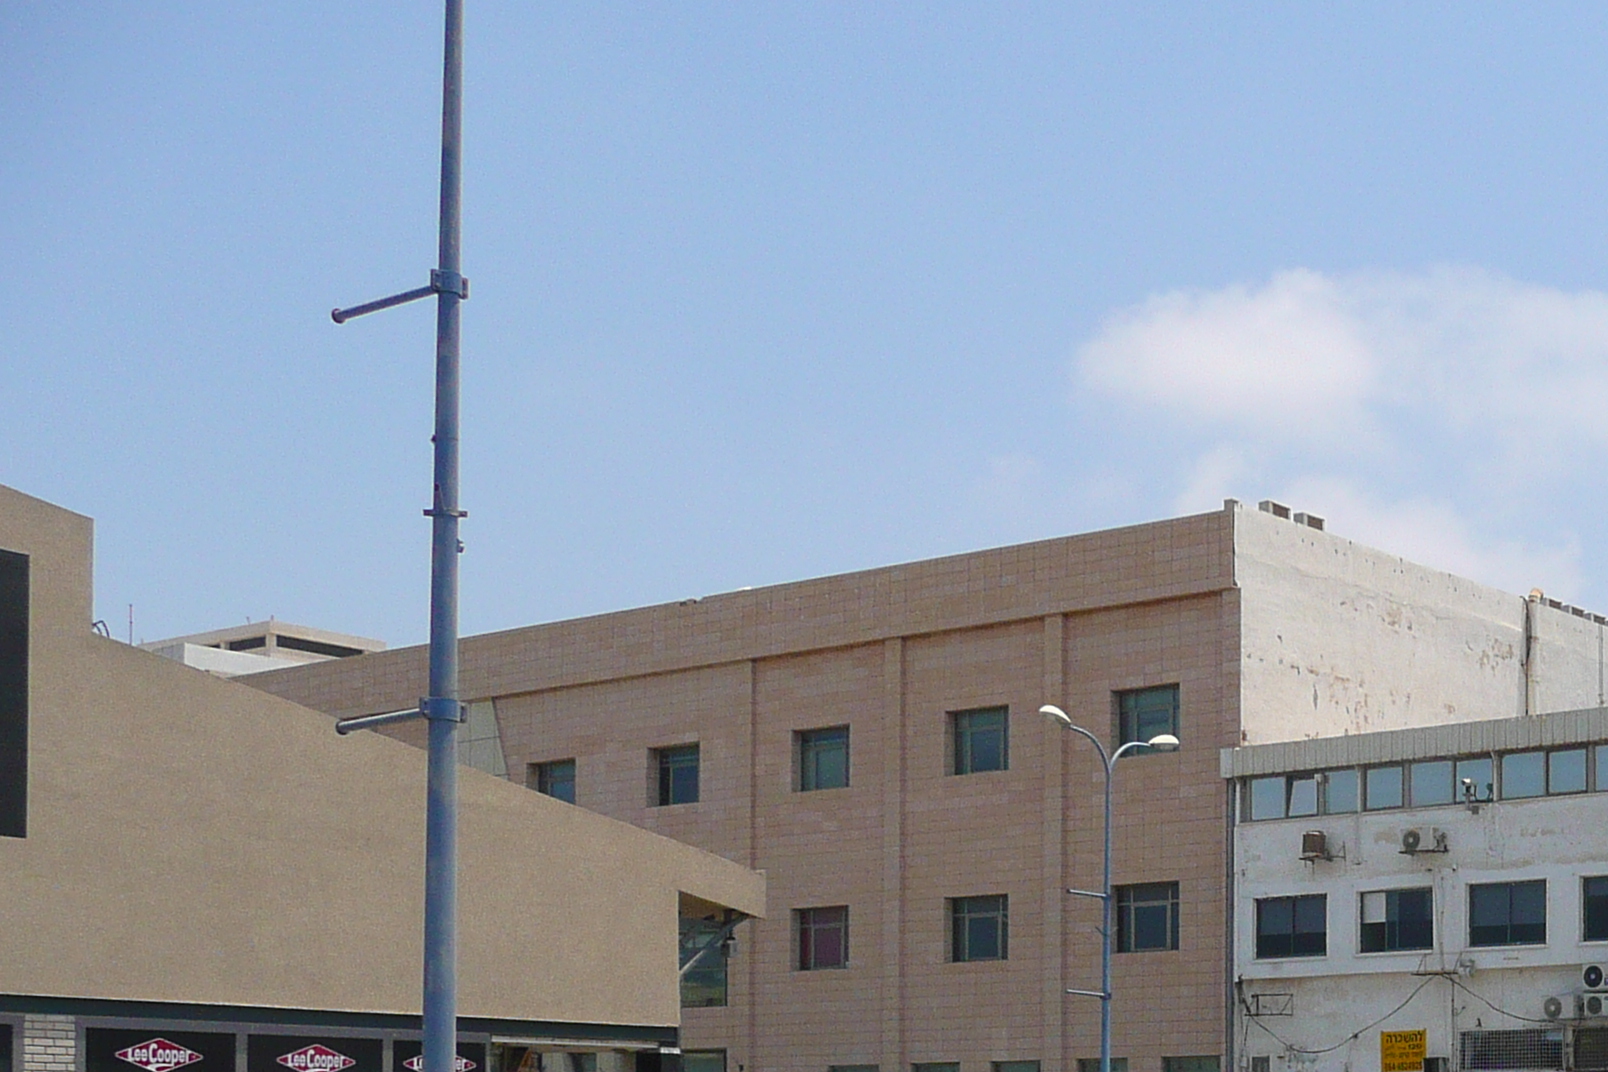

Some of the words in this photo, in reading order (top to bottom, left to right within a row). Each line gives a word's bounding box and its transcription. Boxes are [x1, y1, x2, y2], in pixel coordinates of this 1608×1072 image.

[1386, 1031, 1423, 1044] להשכרה
[127, 1047, 148, 1063] Lee
[148, 1043, 190, 1065] Cooper
[287, 1053, 307, 1068] Lee
[306, 1049, 344, 1069] Cooper
